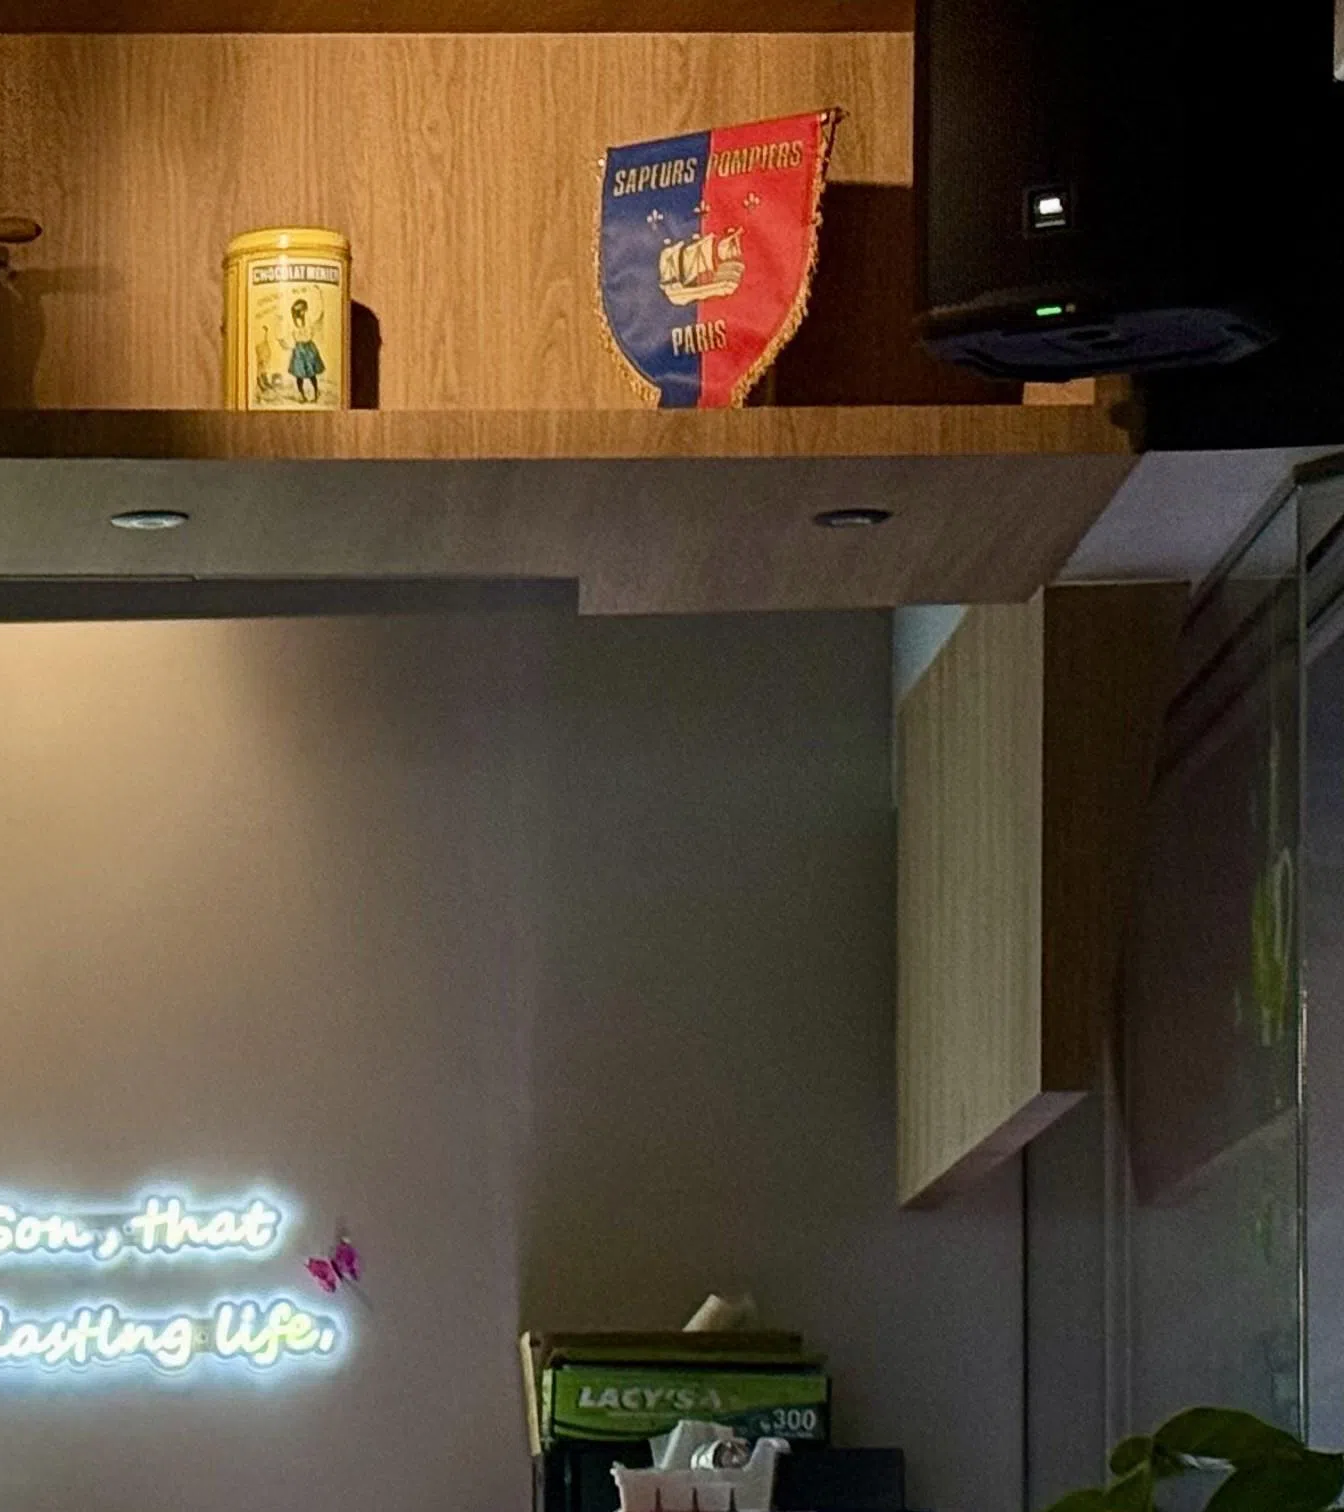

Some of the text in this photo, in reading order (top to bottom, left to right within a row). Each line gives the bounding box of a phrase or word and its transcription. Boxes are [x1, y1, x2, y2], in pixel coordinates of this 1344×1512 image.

[612, 140, 804, 197] SAPEURS POMPIERS
[671, 319, 727, 356] PARIS
[132, 1198, 275, 1247] that
[772, 1408, 816, 1431] 300
